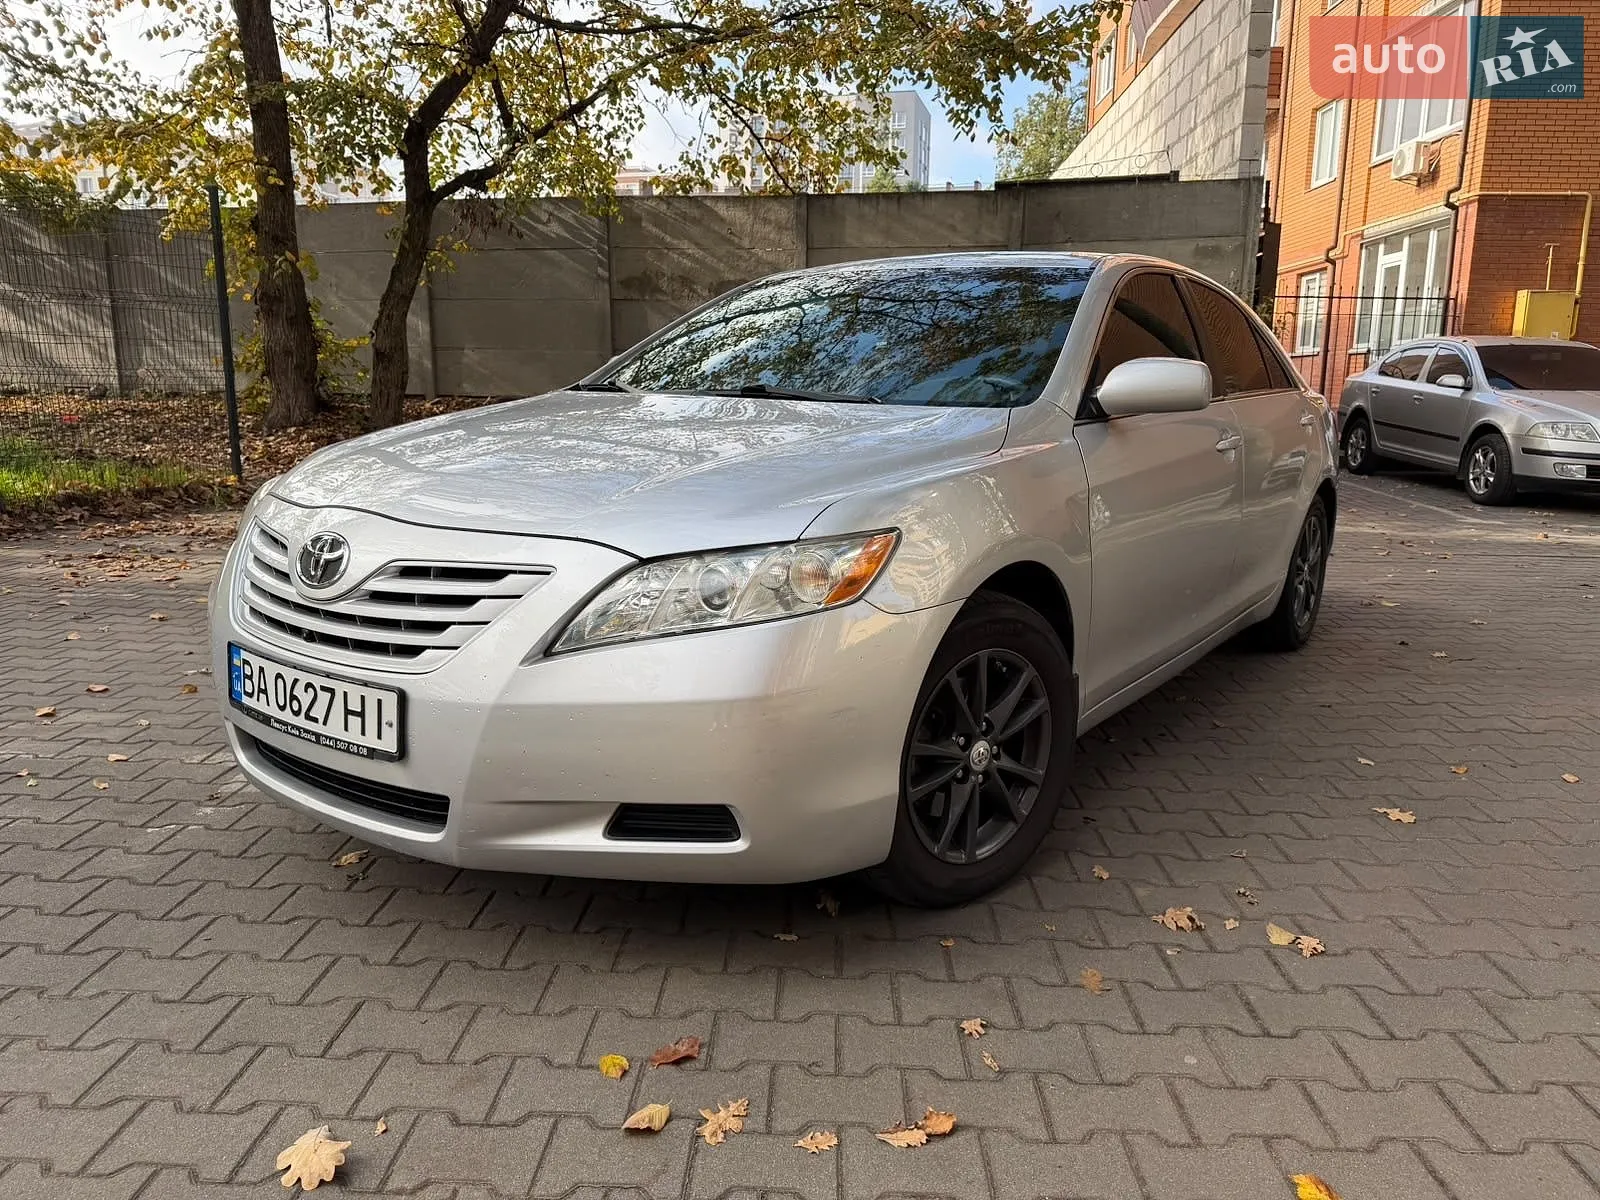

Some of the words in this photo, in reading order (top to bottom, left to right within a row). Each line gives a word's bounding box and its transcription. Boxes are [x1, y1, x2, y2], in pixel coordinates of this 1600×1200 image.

[242, 657, 270, 707] BA
[274, 672, 336, 727] 0627
[343, 690, 382, 740] HI
[320, 735, 335, 748] (044)
[336, 740, 348, 750] 507
